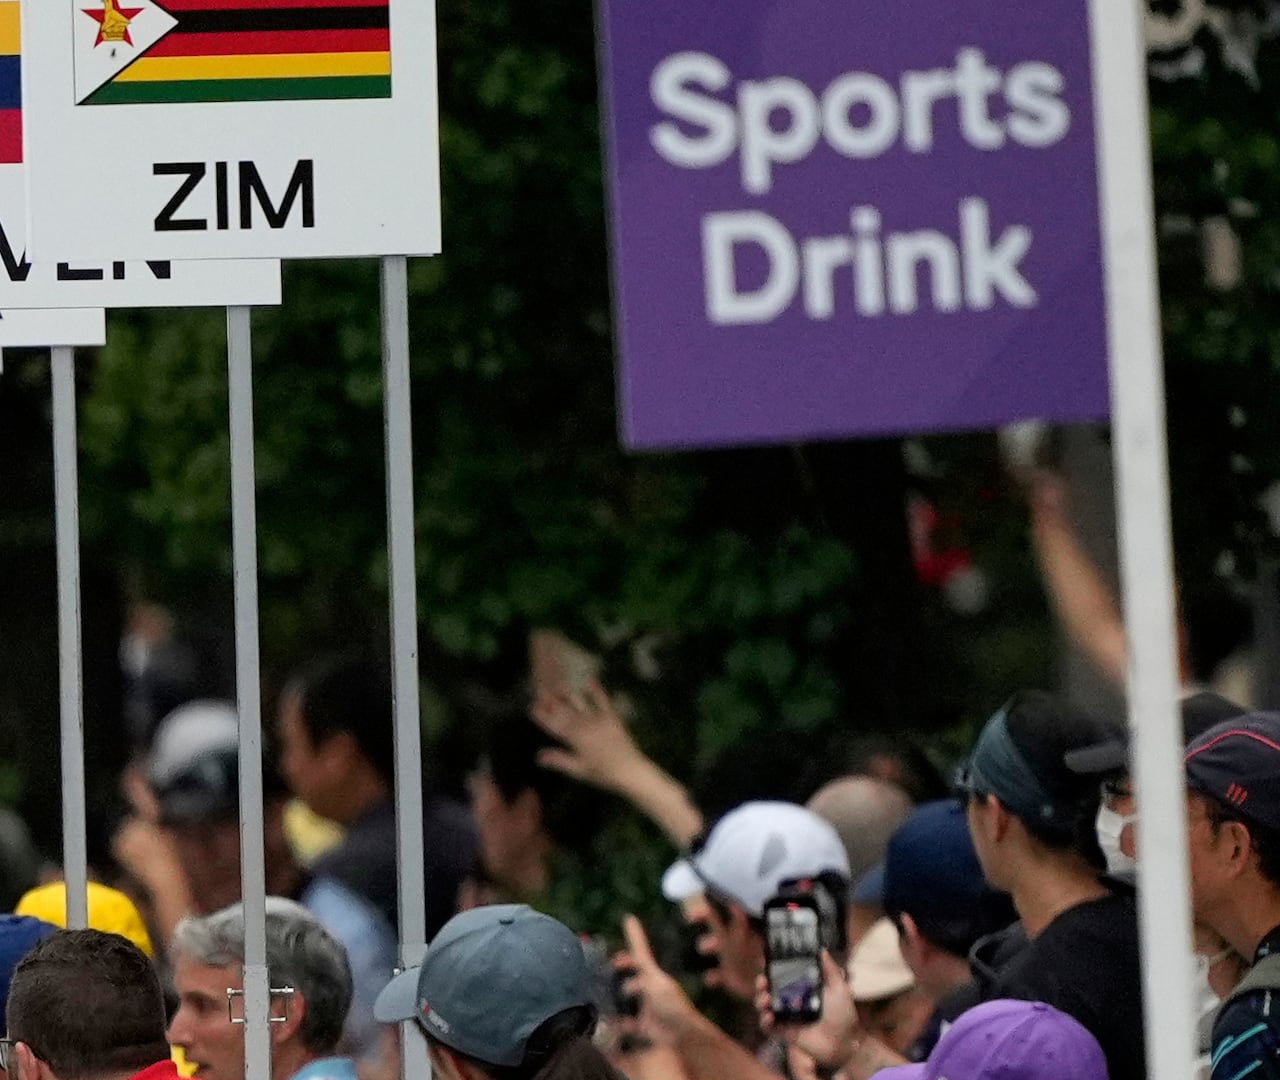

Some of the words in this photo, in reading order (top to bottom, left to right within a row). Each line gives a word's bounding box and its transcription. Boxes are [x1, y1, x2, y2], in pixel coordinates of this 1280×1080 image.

[649, 46, 1071, 195] Sports
[153, 159, 314, 231] ZIM
[700, 196, 1038, 326] Drink
